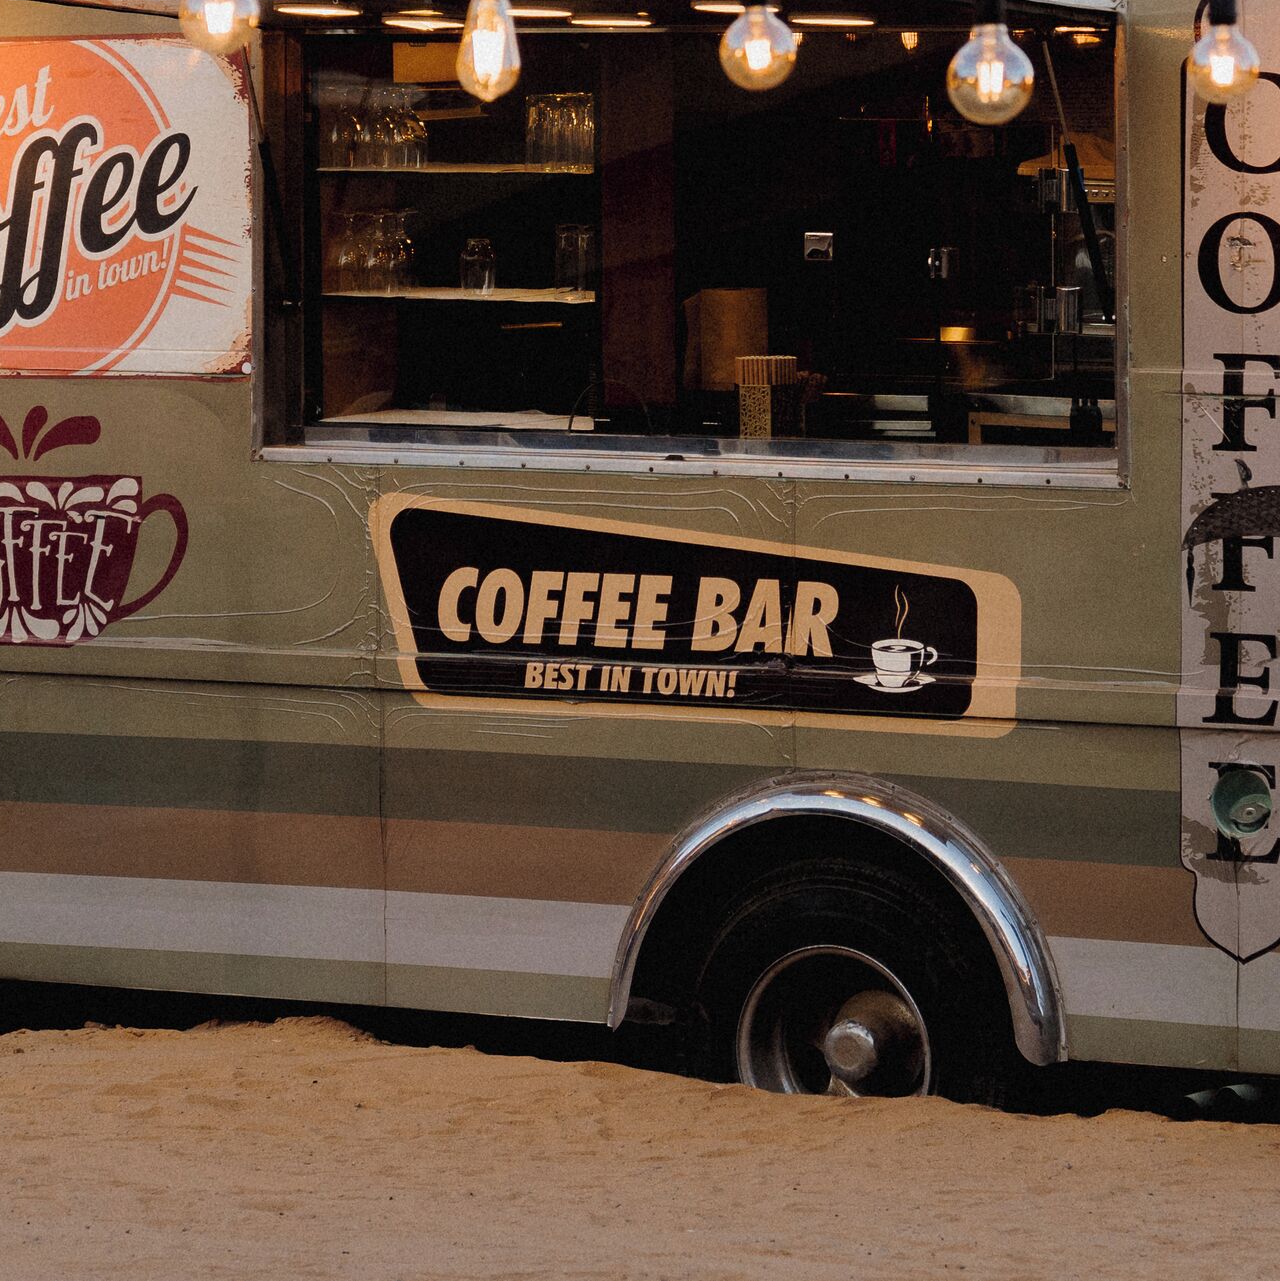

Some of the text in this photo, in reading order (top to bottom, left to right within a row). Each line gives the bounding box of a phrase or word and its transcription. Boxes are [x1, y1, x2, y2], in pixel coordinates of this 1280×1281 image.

[66, 239, 170, 302] in town!
[437, 566, 840, 658] COFFEE BAR
[524, 662, 738, 698] BEST IN TOWN!
